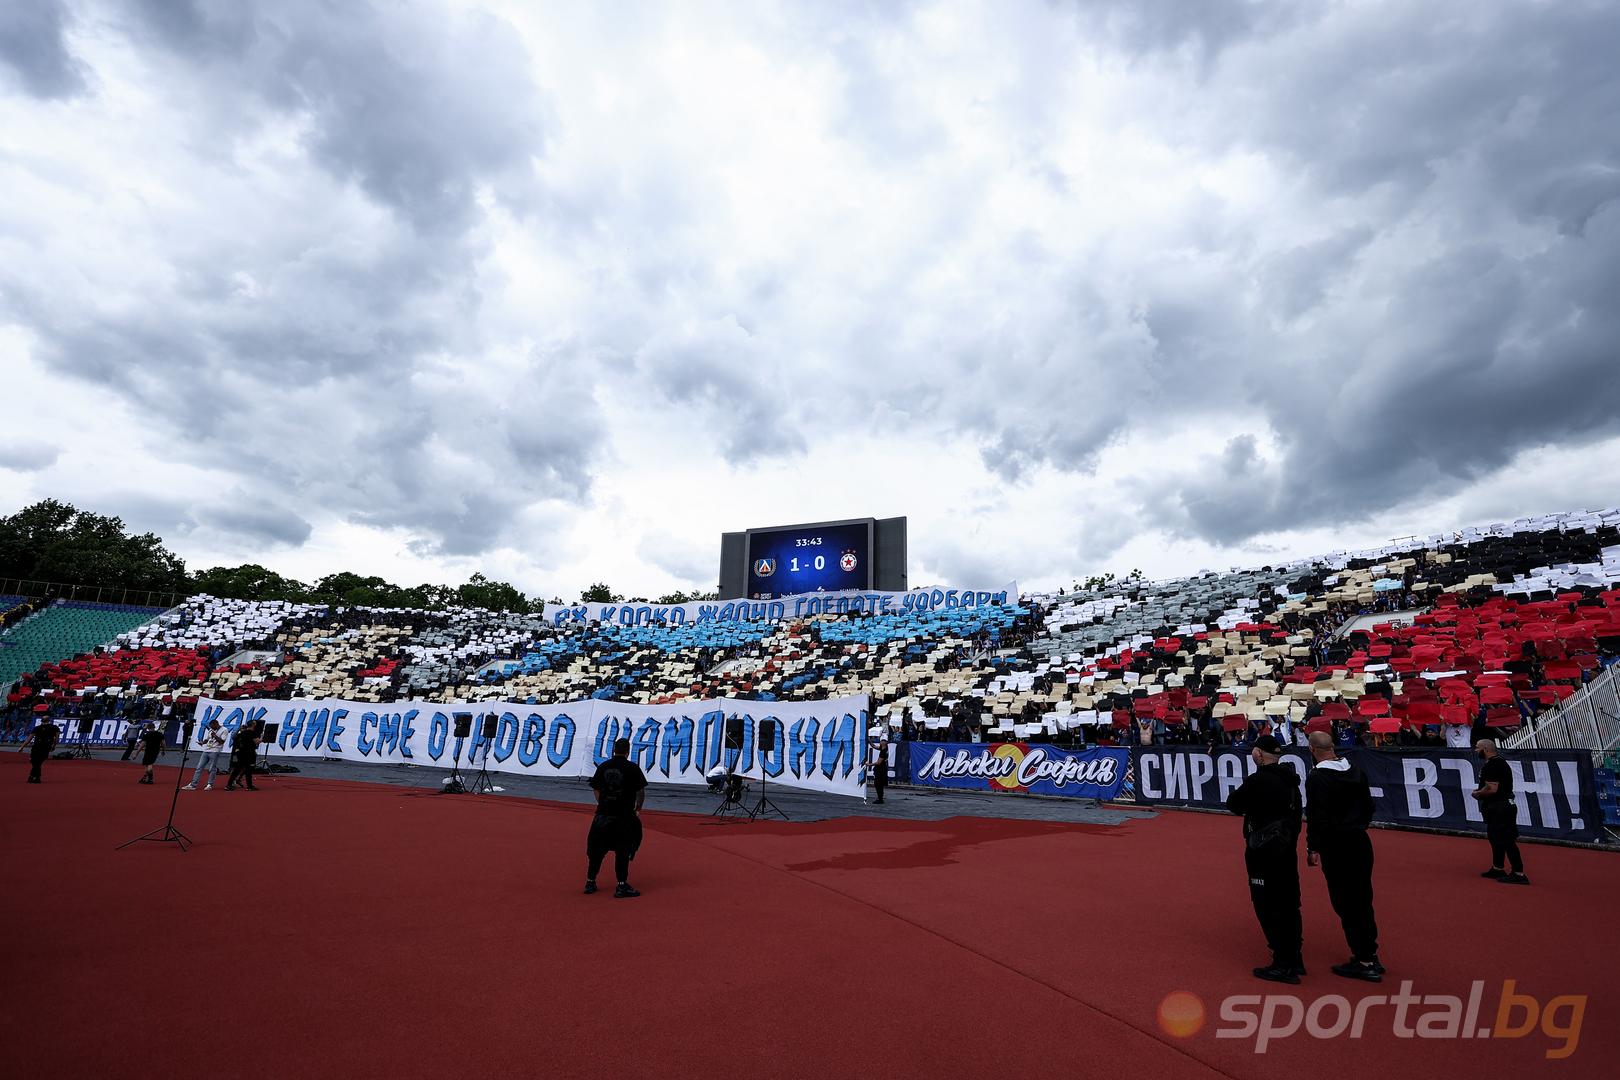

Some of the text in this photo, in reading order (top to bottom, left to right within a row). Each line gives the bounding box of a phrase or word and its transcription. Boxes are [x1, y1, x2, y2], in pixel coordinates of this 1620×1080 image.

[795, 537, 822, 547] 33:43
[790, 557, 800, 572] 1
[814, 555, 825, 570] 0
[279, 707, 349, 752] НИЕ
[357, 709, 419, 759] СМЕ
[918, 748, 1016, 780] Левски
[1018, 748, 1118, 788] София
